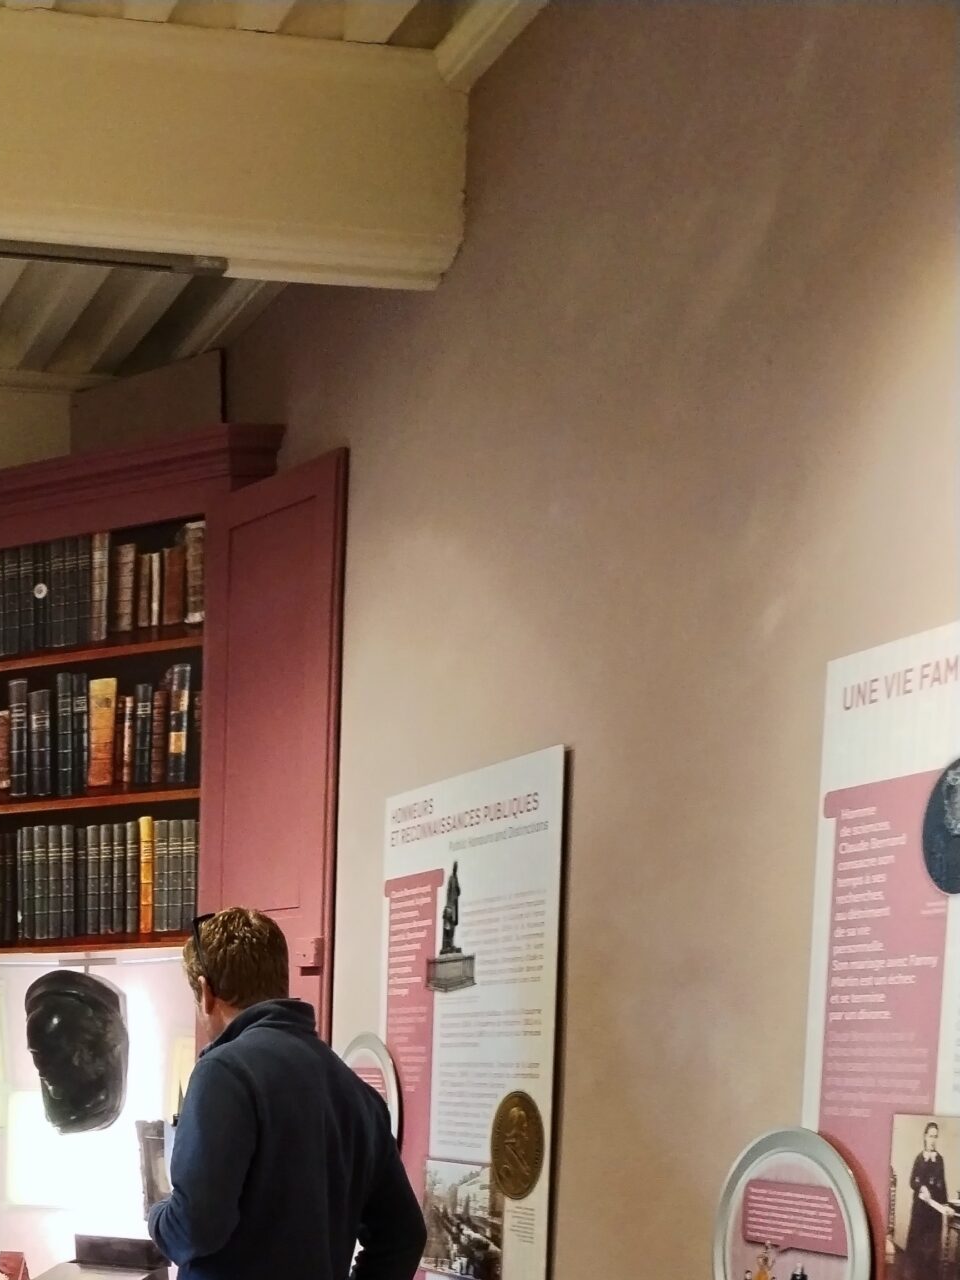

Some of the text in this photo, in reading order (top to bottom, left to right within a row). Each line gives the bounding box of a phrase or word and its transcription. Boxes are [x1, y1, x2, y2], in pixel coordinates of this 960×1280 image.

[842, 655, 960, 711] UNE VIE FAM
[392, 798, 434, 824] HONNEURS
[390, 792, 539, 848] ET RECONNAISSANCES PUBLIQUES
[840, 826, 852, 837] de
[839, 834, 907, 854] Claude Bernard
[837, 855, 895, 871] consacre son
[836, 876, 863, 889] temps
[873, 873, 887, 883] ses
[834, 927, 845, 938] de
[846, 927, 857, 937] sa
[832, 960, 851, 971] Son
[852, 958, 885, 971] mariage
[886, 957, 908, 968] avec
[860, 976, 873, 986] est
[874, 976, 887, 986] un
[887, 973, 917, 985] échec
[829, 992, 886, 1004] et se termine
[828, 1010, 845, 1022] par
[845, 1011, 857, 1020] un
